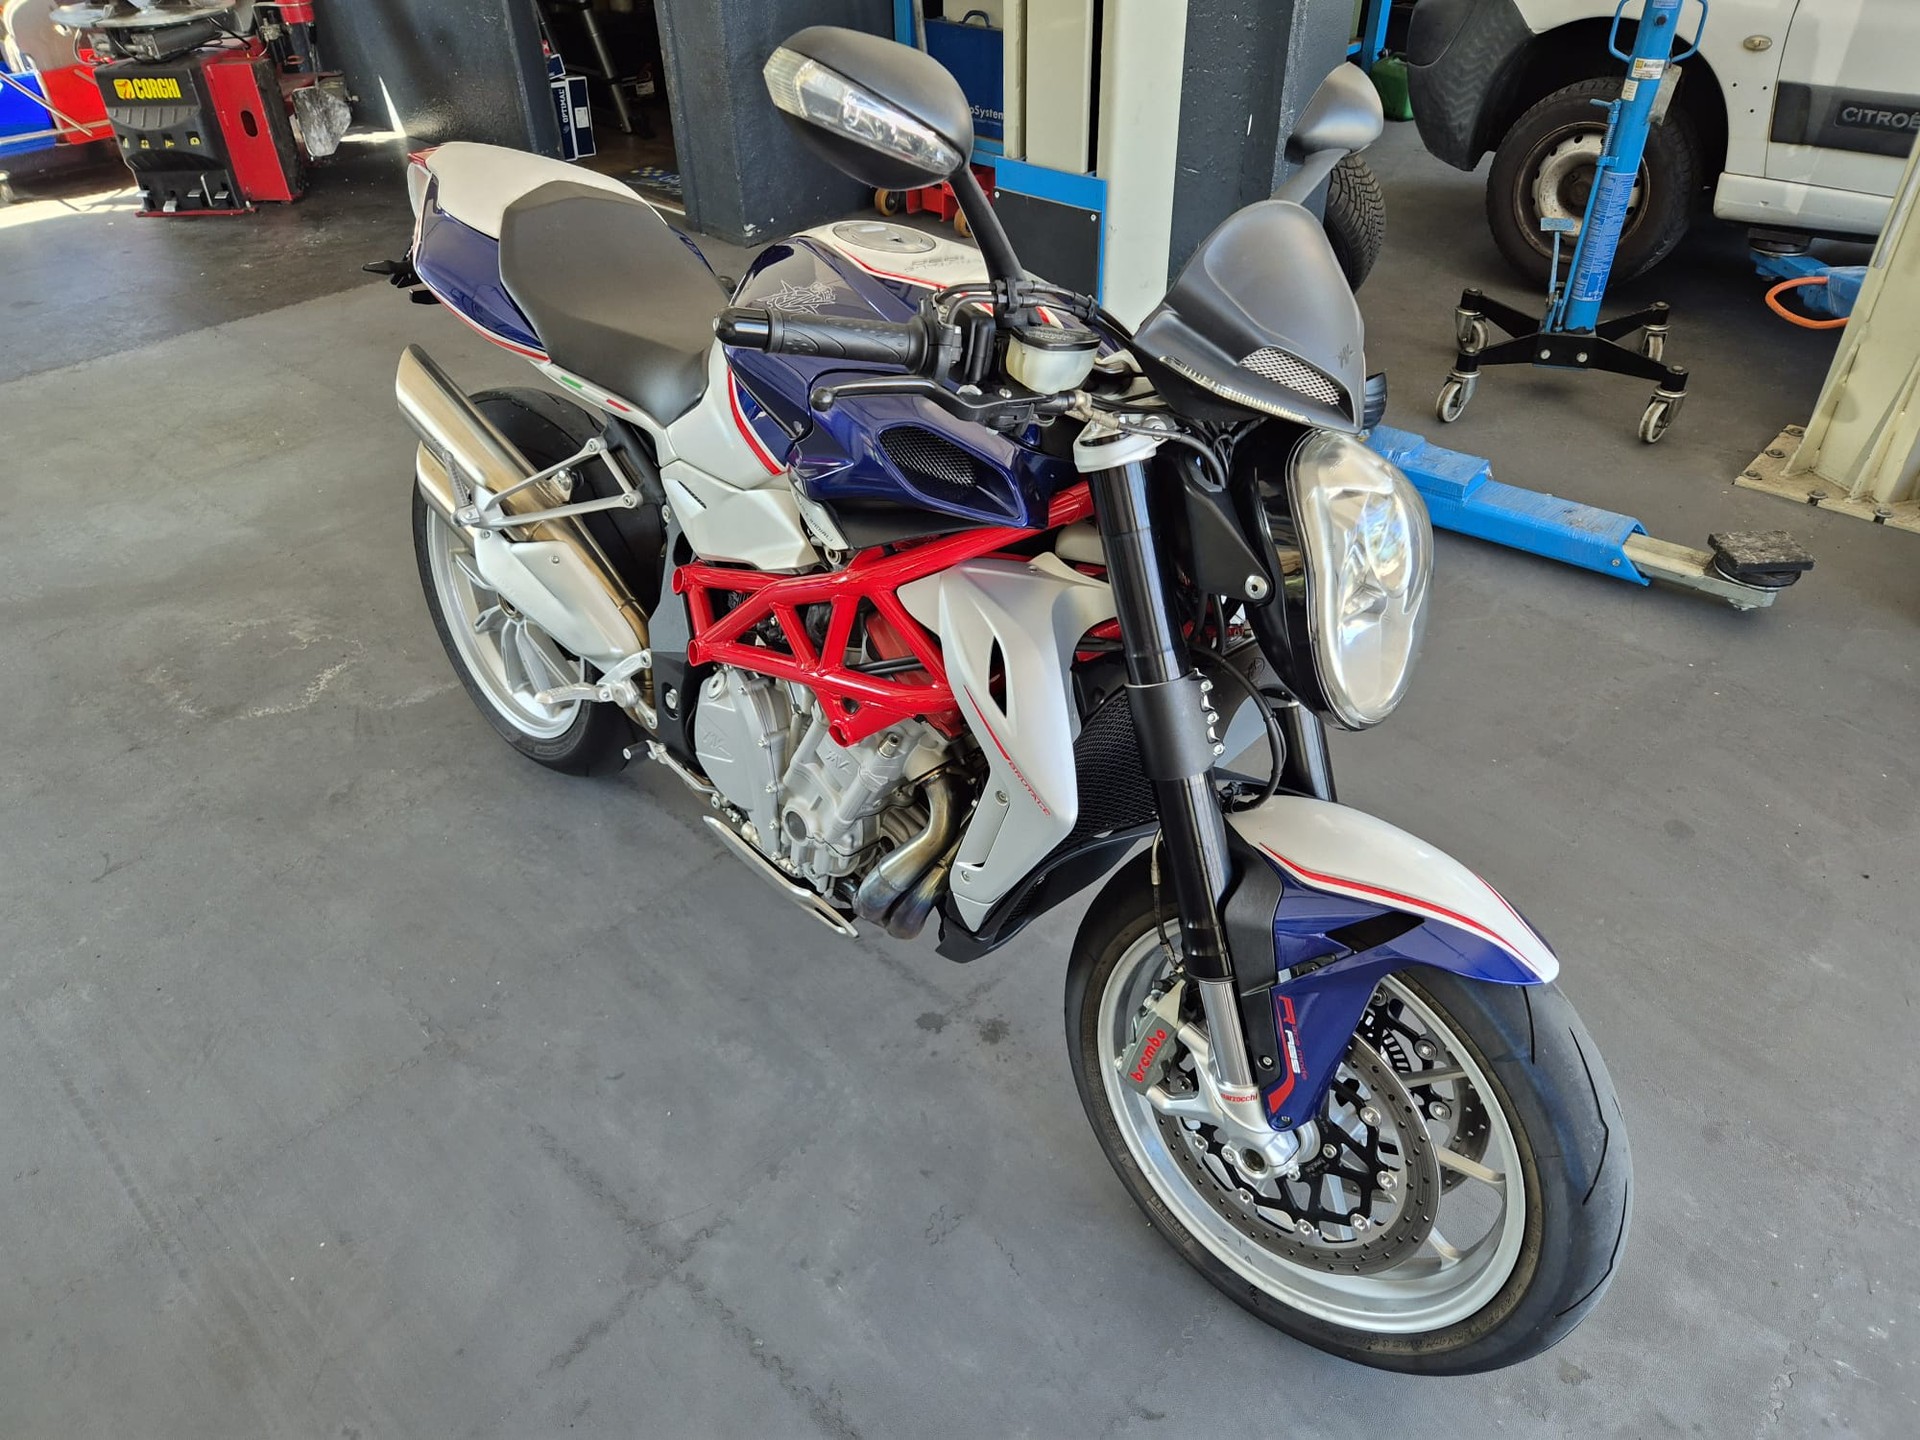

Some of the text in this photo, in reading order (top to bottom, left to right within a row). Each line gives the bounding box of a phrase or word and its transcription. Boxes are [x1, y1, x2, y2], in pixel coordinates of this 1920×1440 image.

[132, 78, 182, 99] CORGHI
[558, 88, 569, 123] OPTIMAL
[1009, 761, 1051, 816] BRUTALE
[1130, 1028, 1167, 1083] brembo
[1284, 1029, 1301, 1074] ABS
